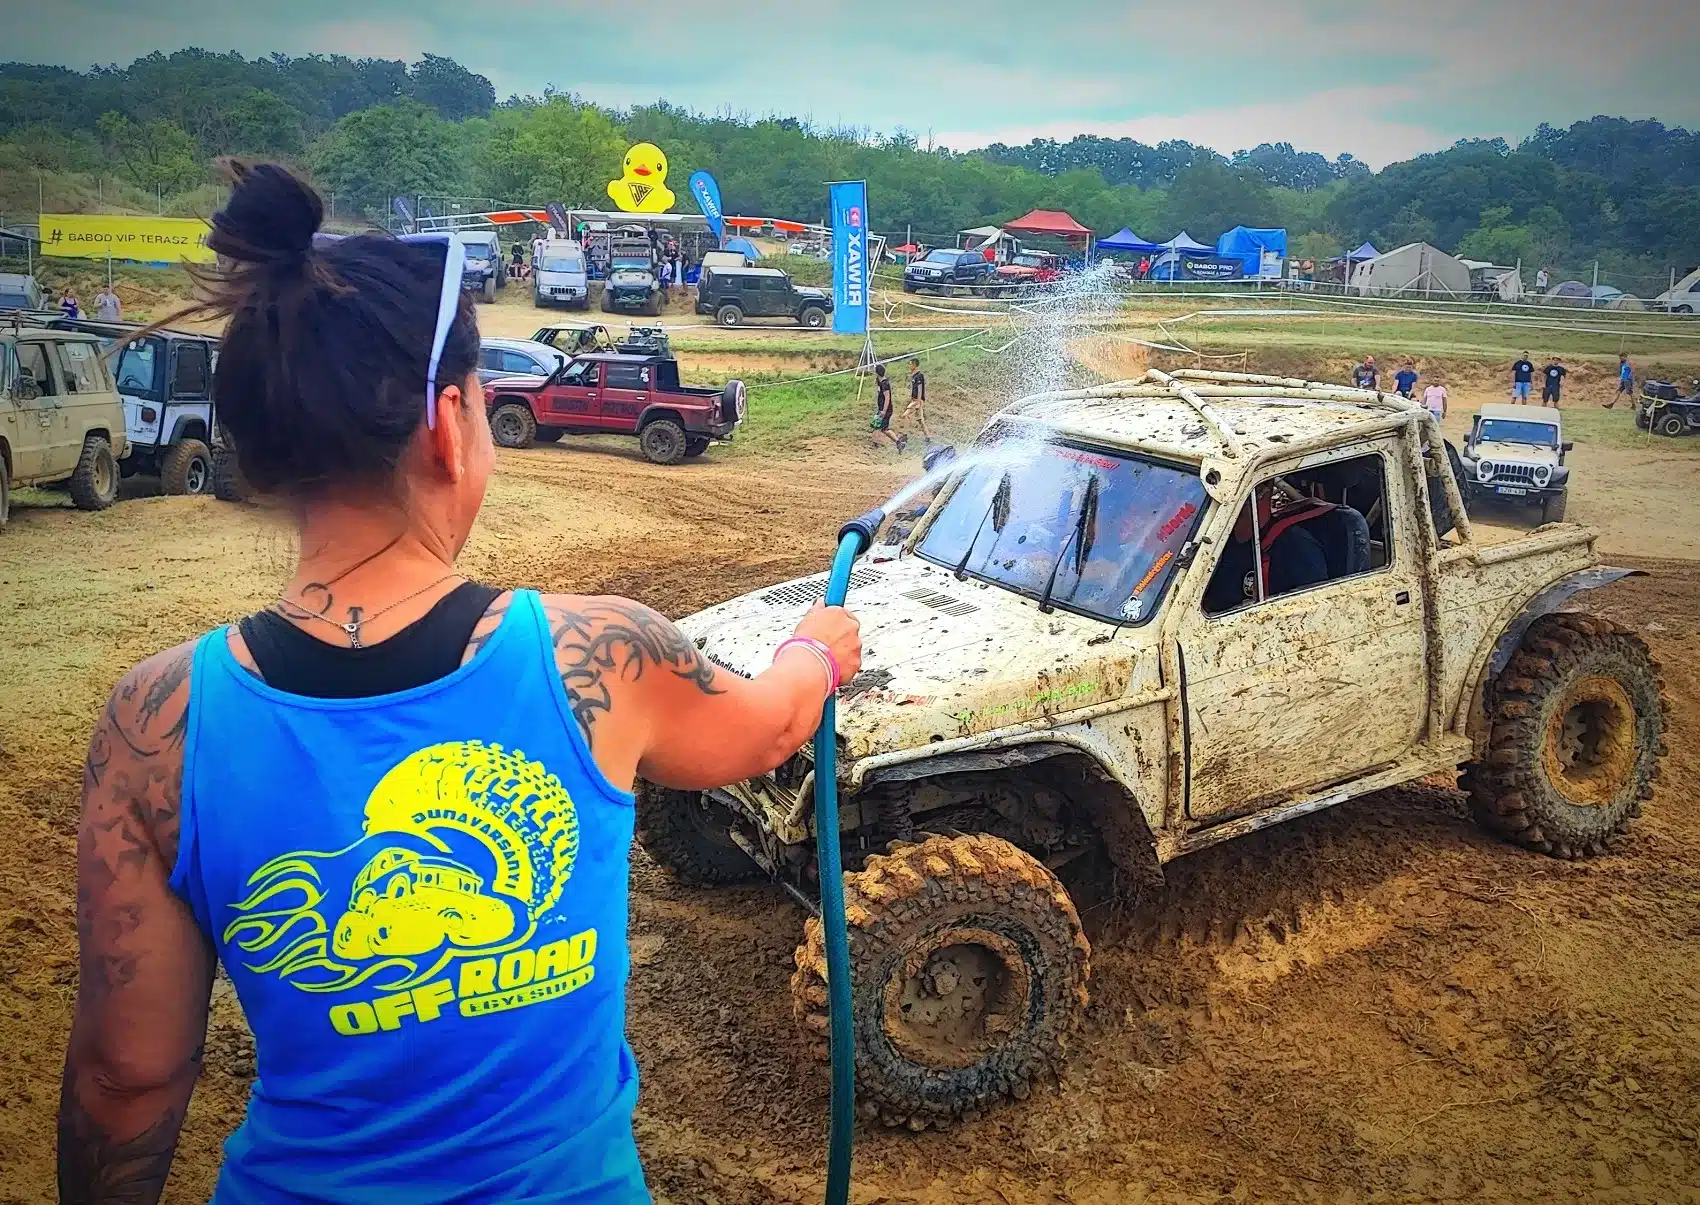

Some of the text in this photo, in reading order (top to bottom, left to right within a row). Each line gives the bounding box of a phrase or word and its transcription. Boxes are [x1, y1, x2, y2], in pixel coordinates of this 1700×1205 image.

[68, 233, 113, 243] BABOD
[116, 234, 136, 243] VIP
[139, 234, 189, 245] TERASZ
[329, 928, 598, 1036] OFF ROAD
